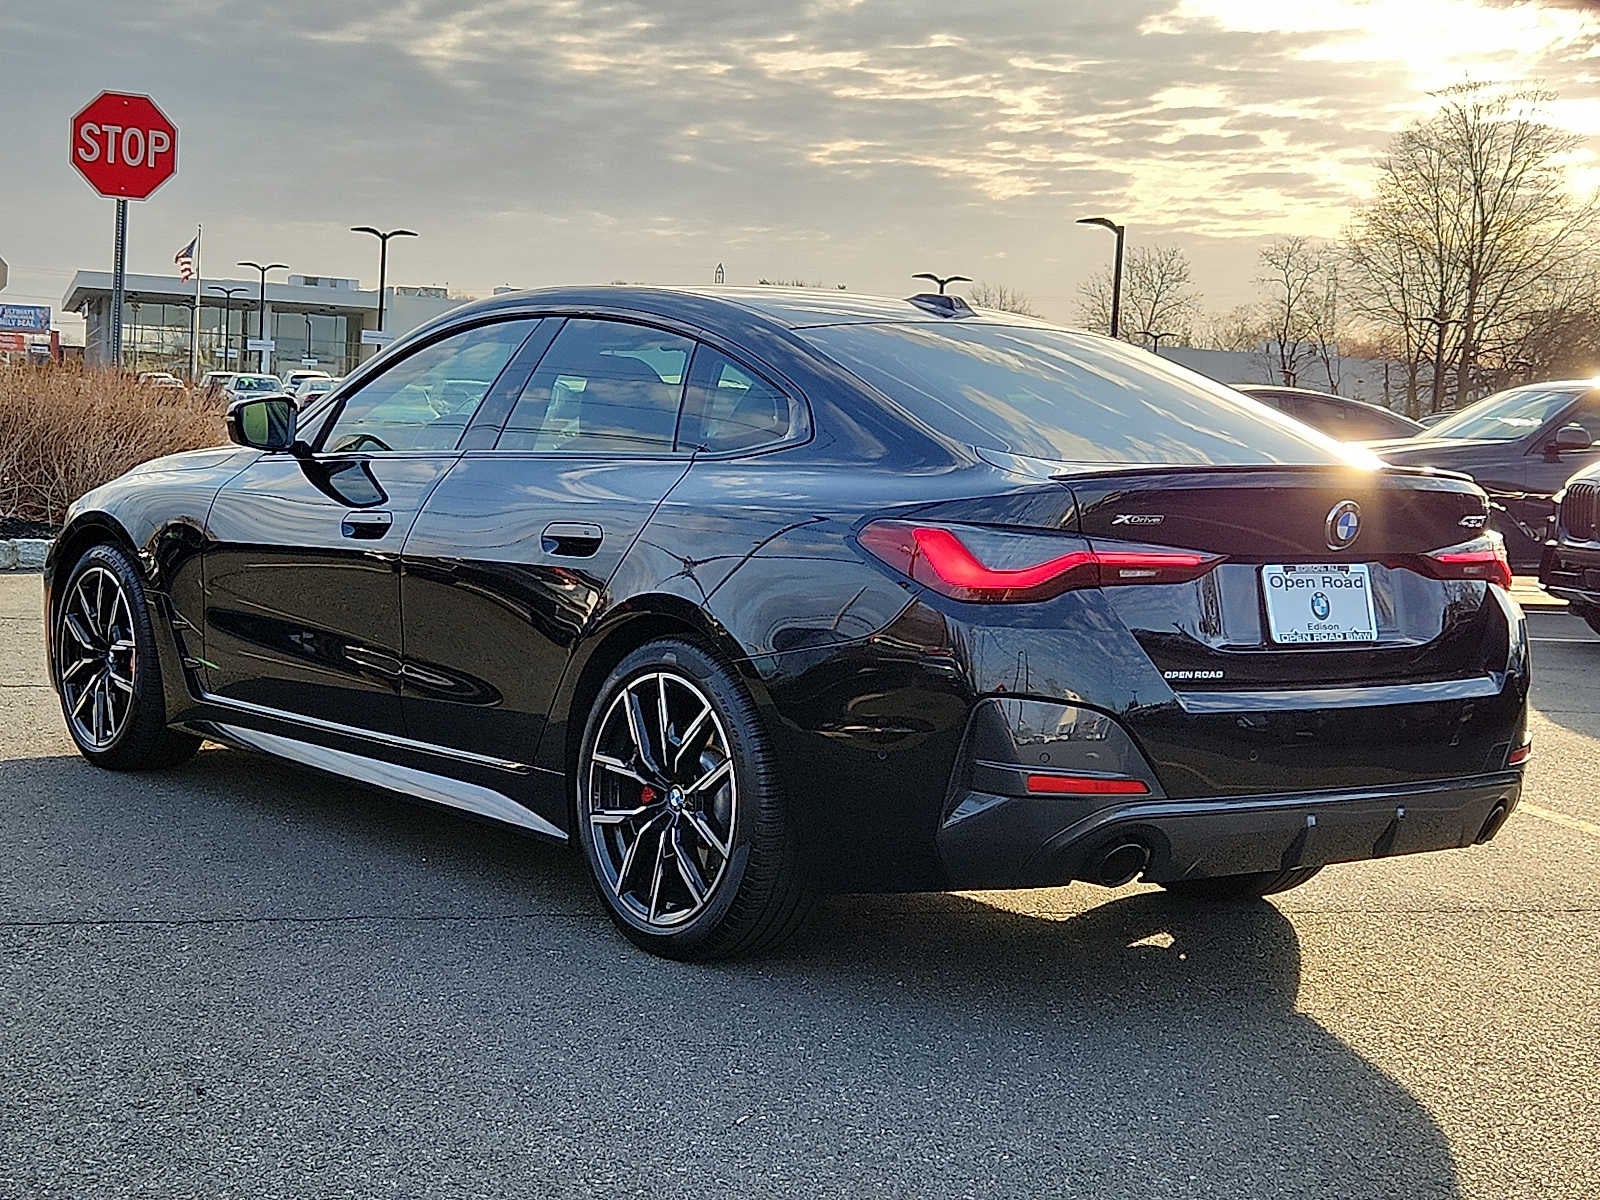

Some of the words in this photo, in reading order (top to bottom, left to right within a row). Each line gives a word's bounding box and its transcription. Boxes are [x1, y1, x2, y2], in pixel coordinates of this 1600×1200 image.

[78, 122, 171, 168] STOP
[1270, 575, 1316, 591] Open
[1321, 575, 1364, 589] Road
[1307, 622, 1340, 631] Edison
[1281, 633, 1311, 642] OPEN
[1314, 632, 1343, 641] ROAD
[1347, 631, 1371, 640] BMW
